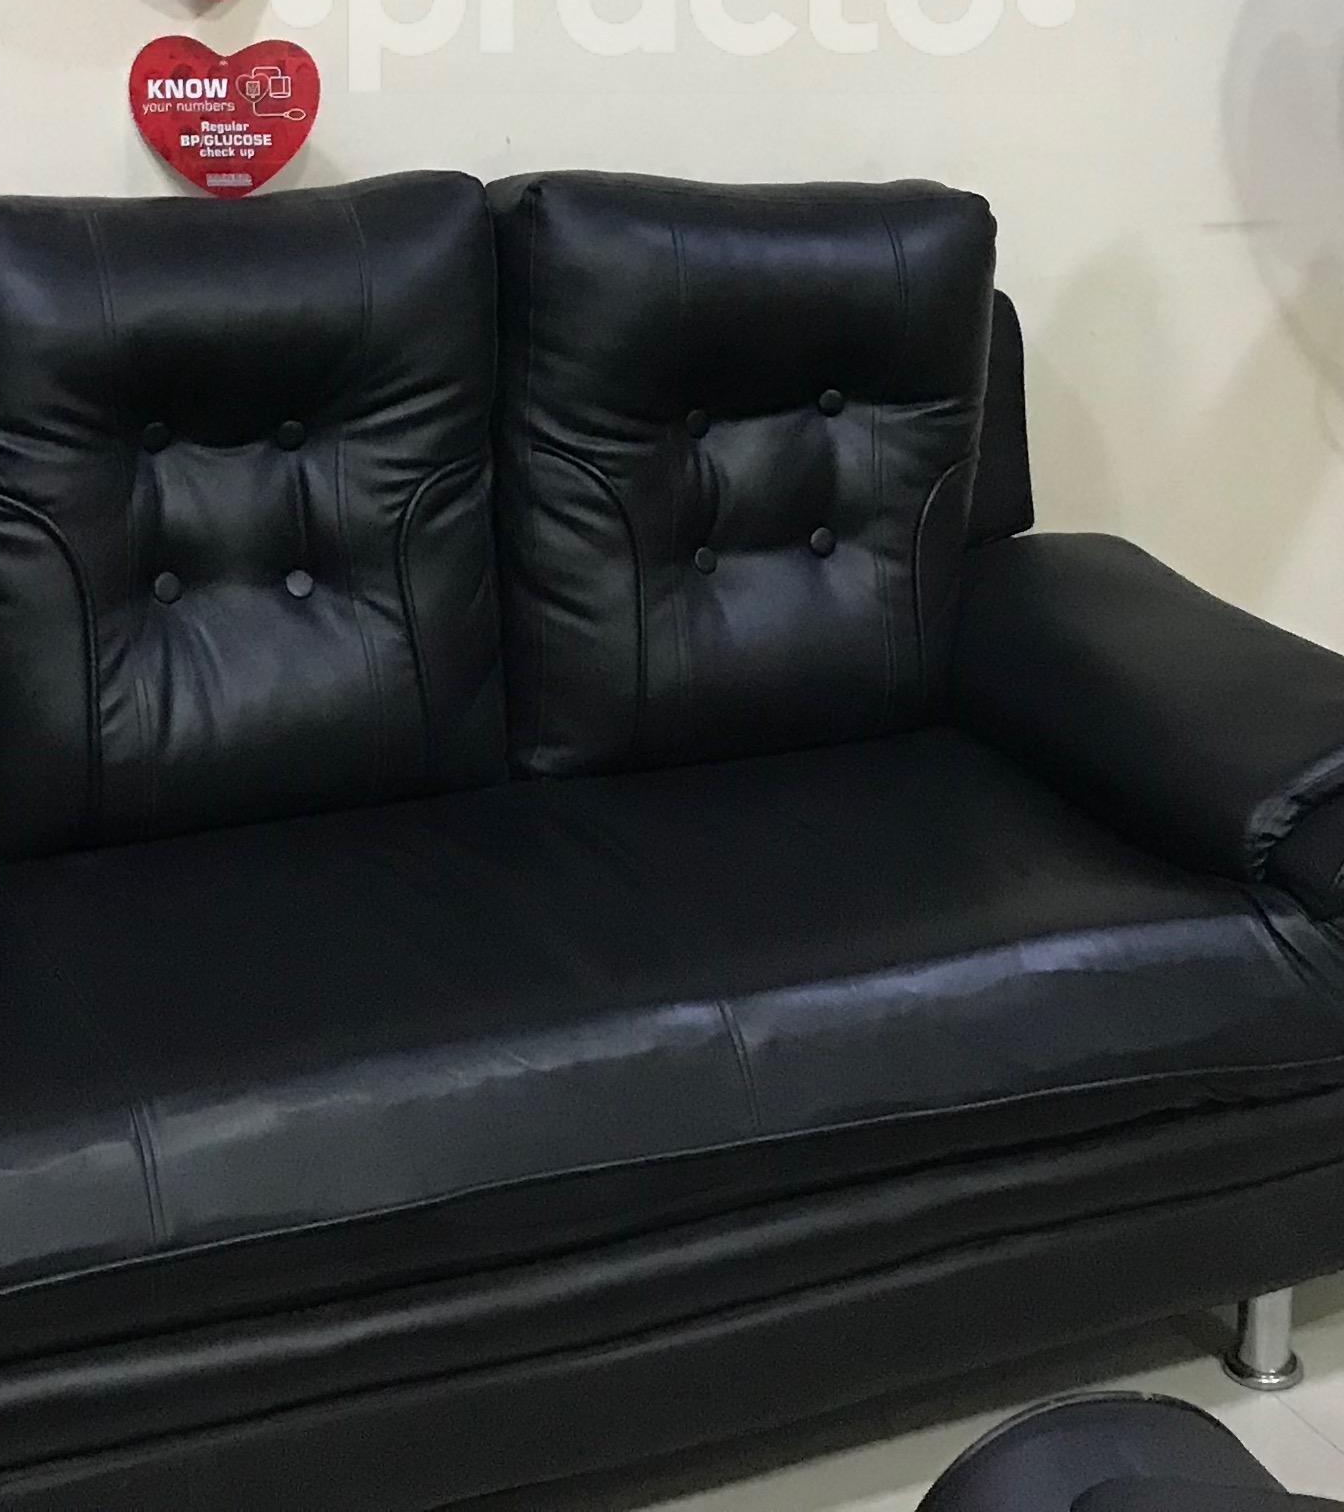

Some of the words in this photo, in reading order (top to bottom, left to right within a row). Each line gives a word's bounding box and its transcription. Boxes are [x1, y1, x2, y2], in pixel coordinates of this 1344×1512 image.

[147, 78, 228, 99] KNOW
[143, 102, 172, 115] your
[176, 100, 235, 112] numbers
[201, 121, 249, 133] Regular
[180, 134, 272, 147] BP/GLUCOSE
[200, 147, 235, 157] check
[240, 148, 255, 159] up
